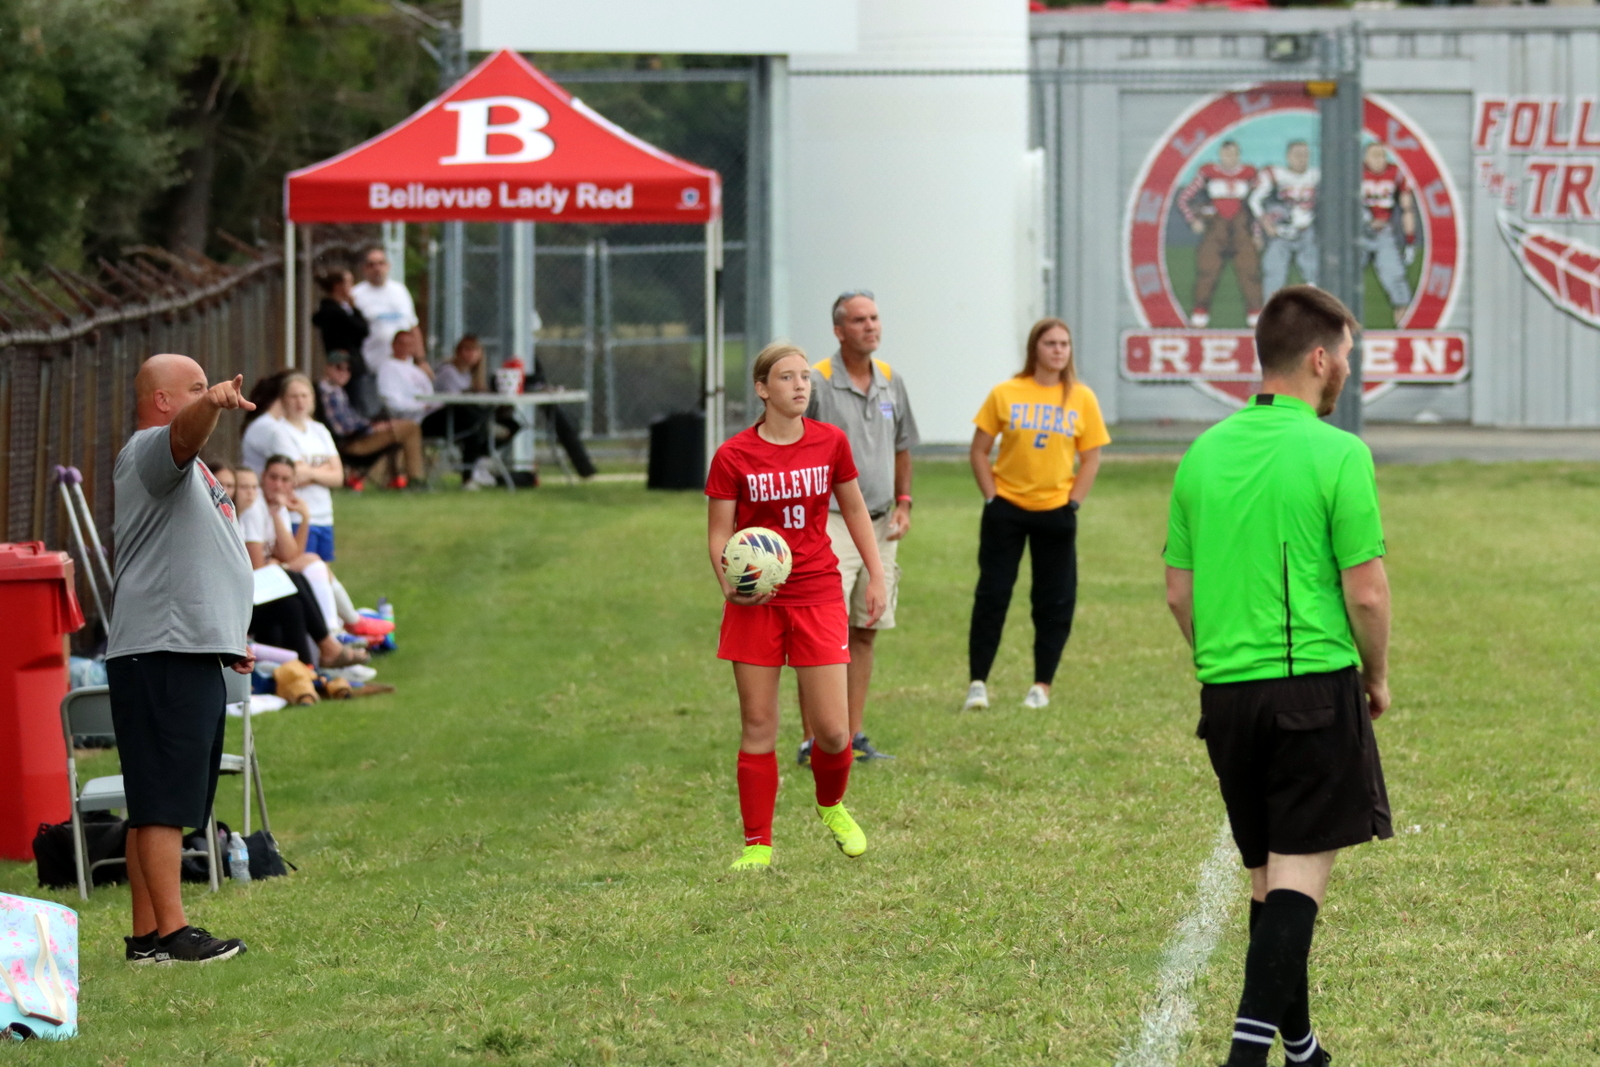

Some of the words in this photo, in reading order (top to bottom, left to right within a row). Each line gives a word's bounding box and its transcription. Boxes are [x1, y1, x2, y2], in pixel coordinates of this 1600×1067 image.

[438, 95, 556, 166] B
[1475, 99, 1600, 149] FOLL
[368, 182, 493, 209] Bellevue
[499, 182, 570, 214] Lady
[576, 183, 634, 209] Red
[1133, 93, 1457, 299] BELLVUE
[1526, 162, 1596, 216] TR
[1151, 337, 1449, 373] REEN
[1009, 403, 1078, 437] FLIERS
[746, 464, 830, 503] BELLEVUE
[782, 504, 806, 530] 19
